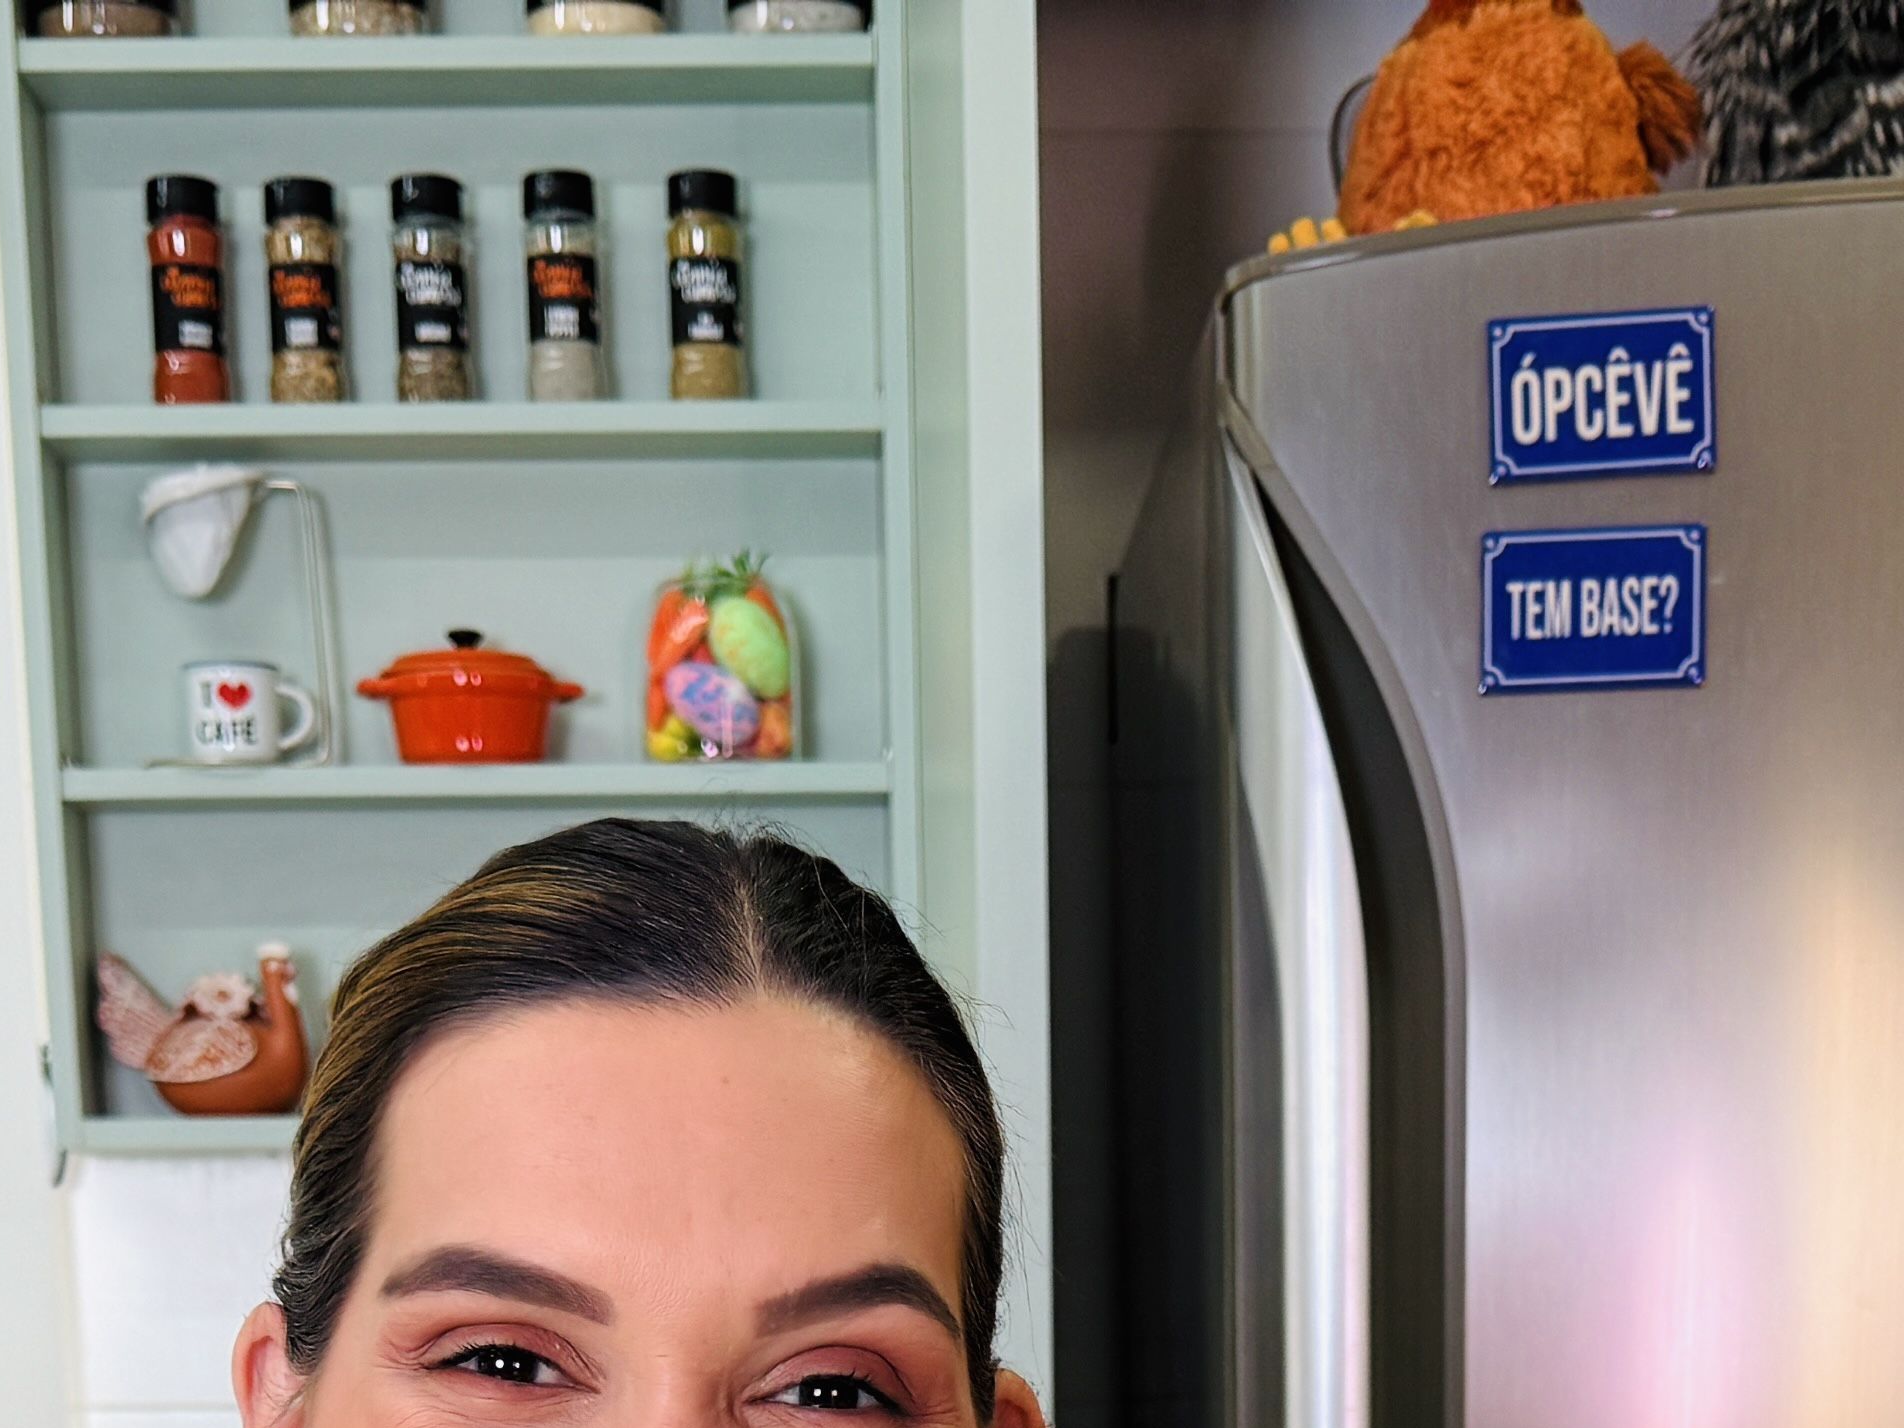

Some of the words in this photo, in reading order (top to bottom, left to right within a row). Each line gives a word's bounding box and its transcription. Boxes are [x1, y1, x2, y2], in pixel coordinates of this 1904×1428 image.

[1511, 342, 1695, 446] ÓPCÊVÊ
[1506, 577, 1573, 641] TEM
[1580, 573, 1680, 638] BASE?
